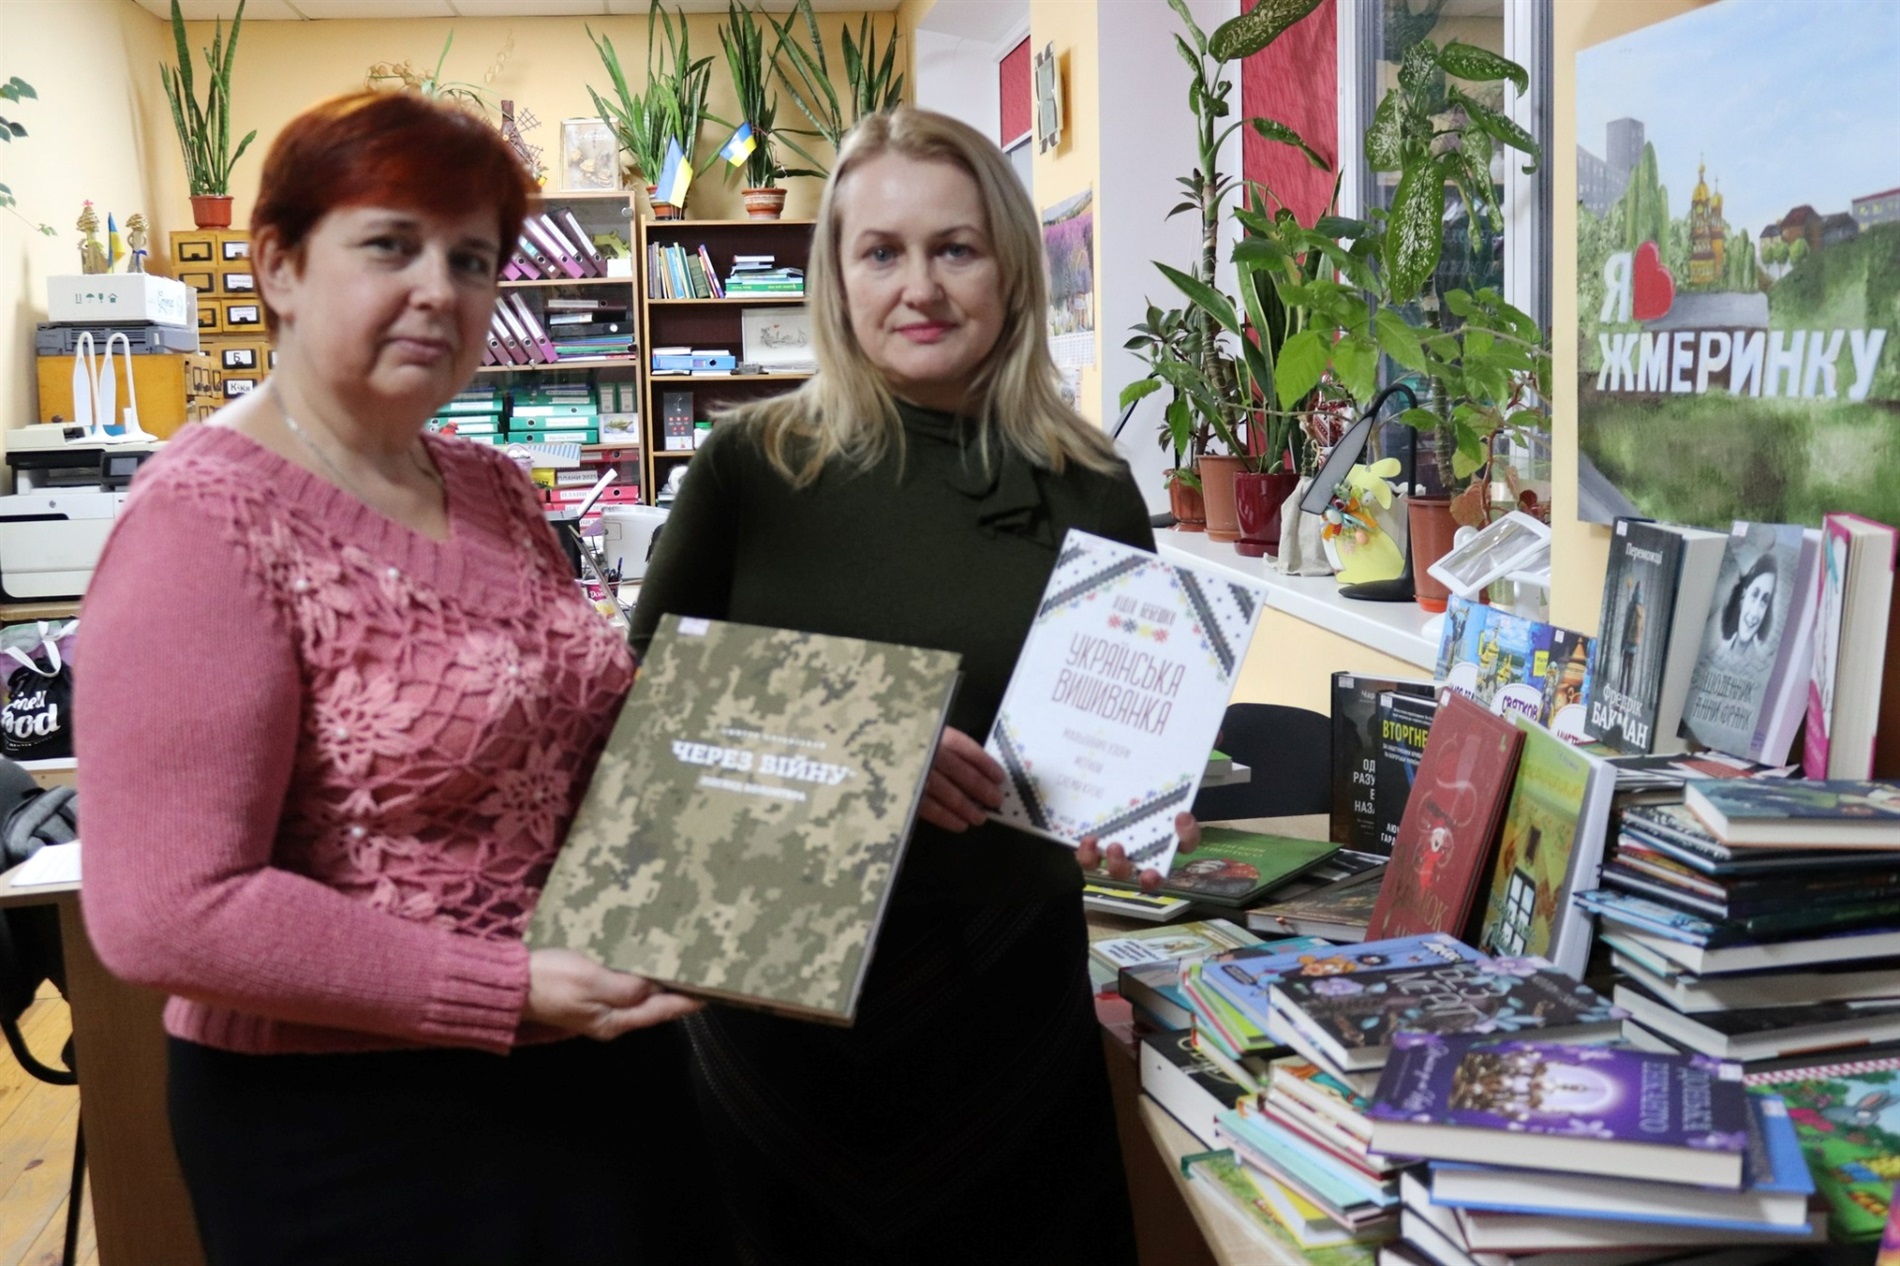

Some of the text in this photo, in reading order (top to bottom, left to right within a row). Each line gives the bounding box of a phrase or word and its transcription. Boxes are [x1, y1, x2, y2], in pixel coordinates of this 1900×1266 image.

[1600, 251, 1633, 324] Я
[1596, 328, 1887, 400] ЖМЕРИНКУ
[1625, 542, 1663, 564] Переможці
[1065, 631, 1186, 698] УКРАЇНСЬКА
[1052, 668, 1173, 735] ВИШИВАНКА
[1591, 701, 1648, 749] БАКМАН
[1382, 719, 1428, 748] ВТОРГНЕ
[671, 739, 857, 786] ЧЕРЕЗ ВІЙНУ
[1353, 771, 1376, 786] РАЗУ
[1363, 759, 1376, 773] ОД
[1354, 800, 1375, 814] НАЗ
